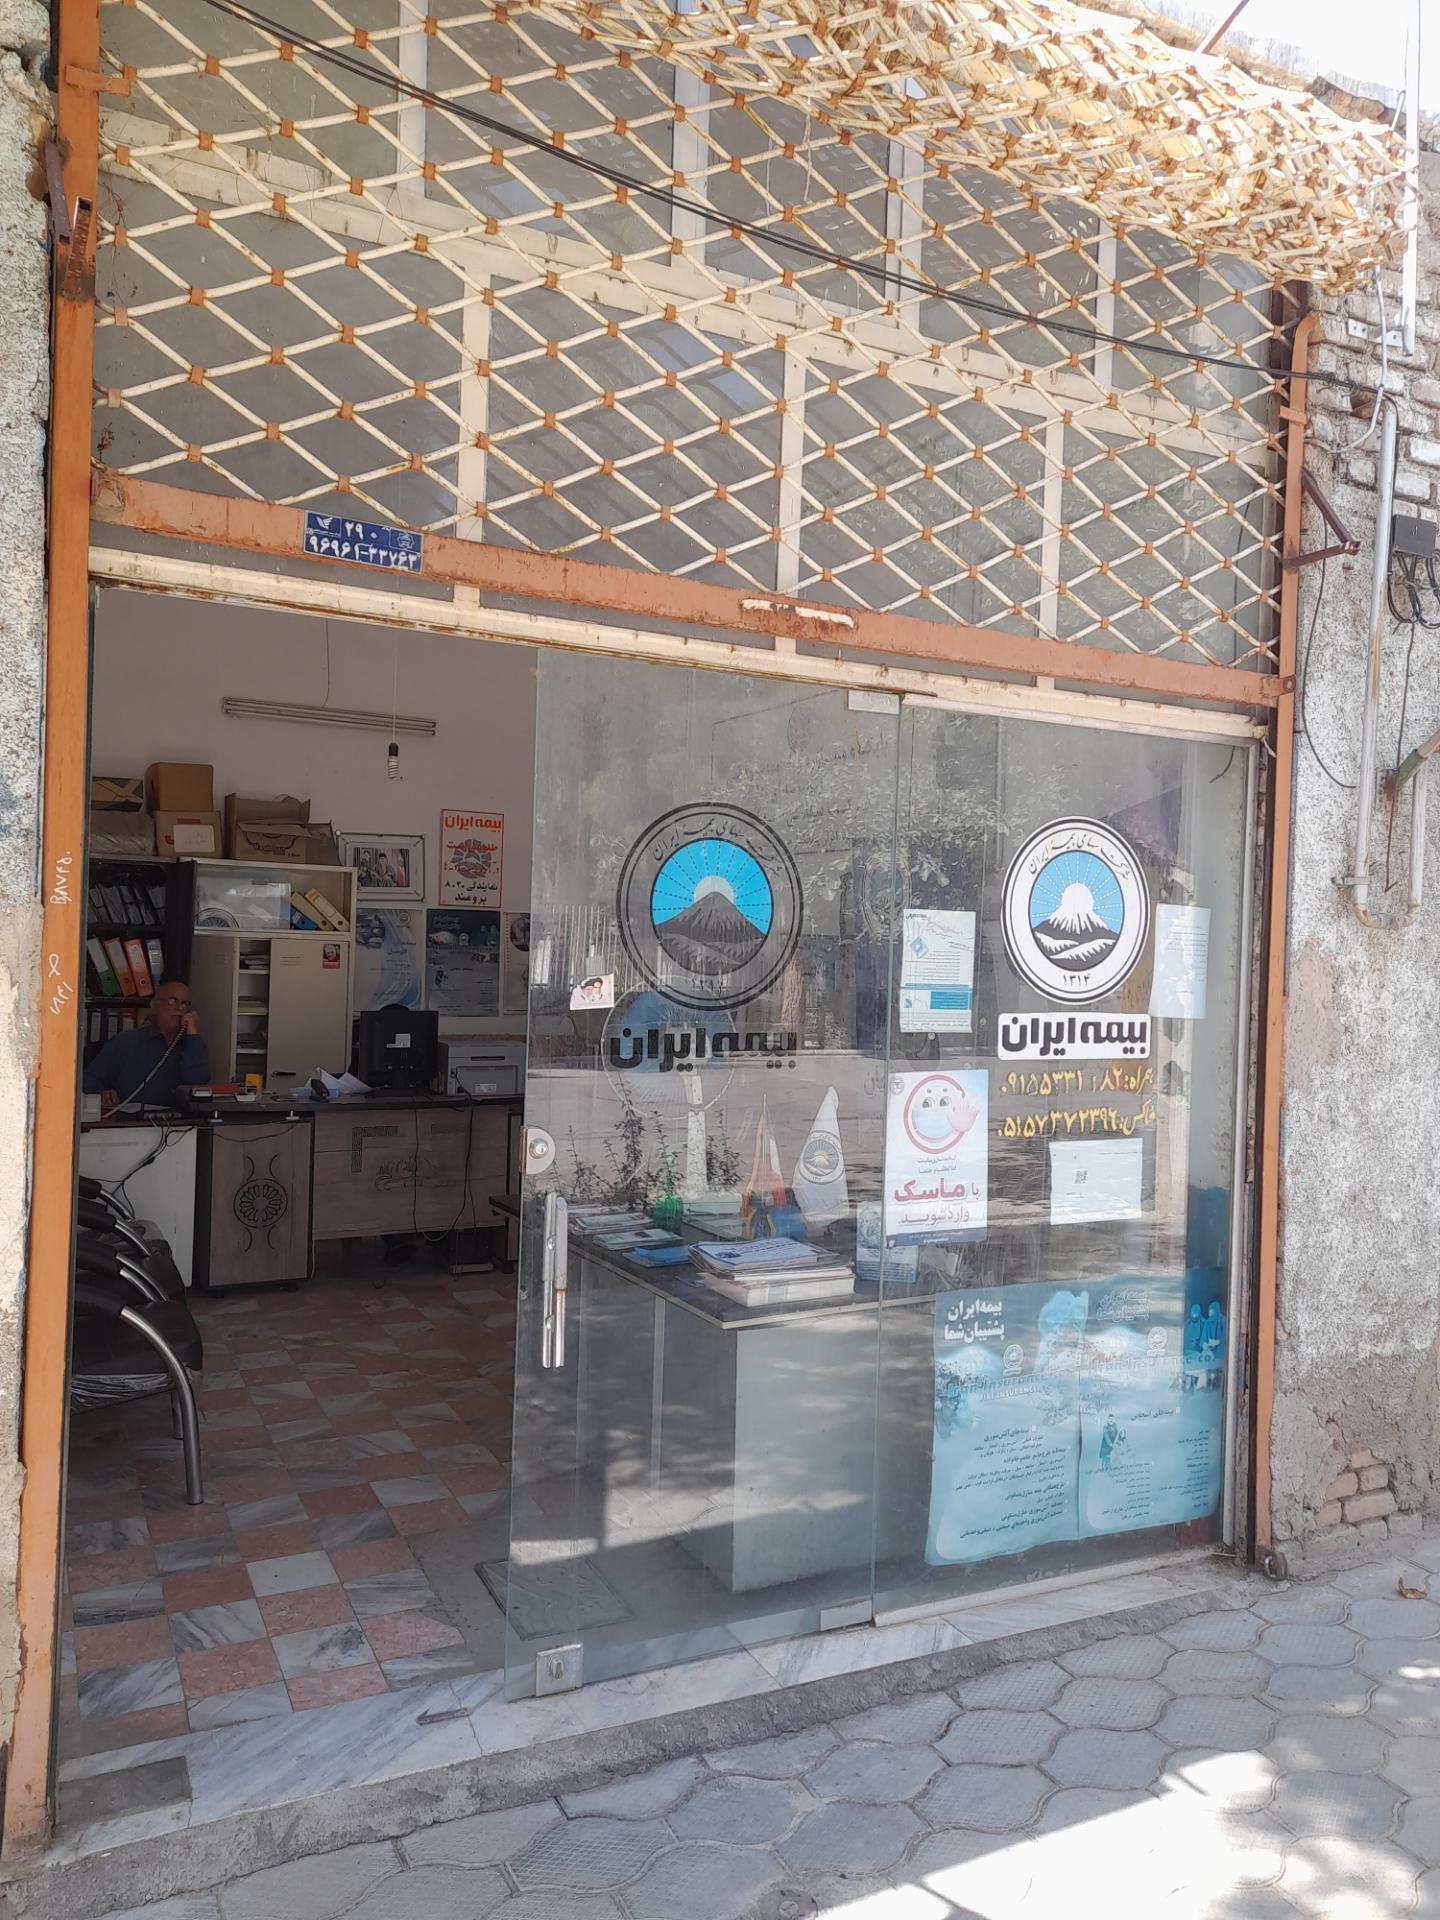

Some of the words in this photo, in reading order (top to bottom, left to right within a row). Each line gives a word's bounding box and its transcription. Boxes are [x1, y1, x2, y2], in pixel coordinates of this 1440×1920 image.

[444, 815, 474, 830] ایران
[475, 818, 502, 832] بیمه
[1063, 973, 1091, 987] ۱۳۱۴
[1002, 1016, 1076, 1056] ایران
[1080, 1021, 1147, 1055] بیمه
[610, 1027, 706, 1072] ایران
[711, 1031, 797, 1069] بیمه
[894, 1177, 966, 1203] ماسک
[971, 1181, 980, 1201] با
[947, 1298, 979, 1321] ایران
[980, 1300, 1002, 1316] بیمه
[944, 1323, 965, 1340] شما
[964, 1320, 1005, 1343] پشتیبان
